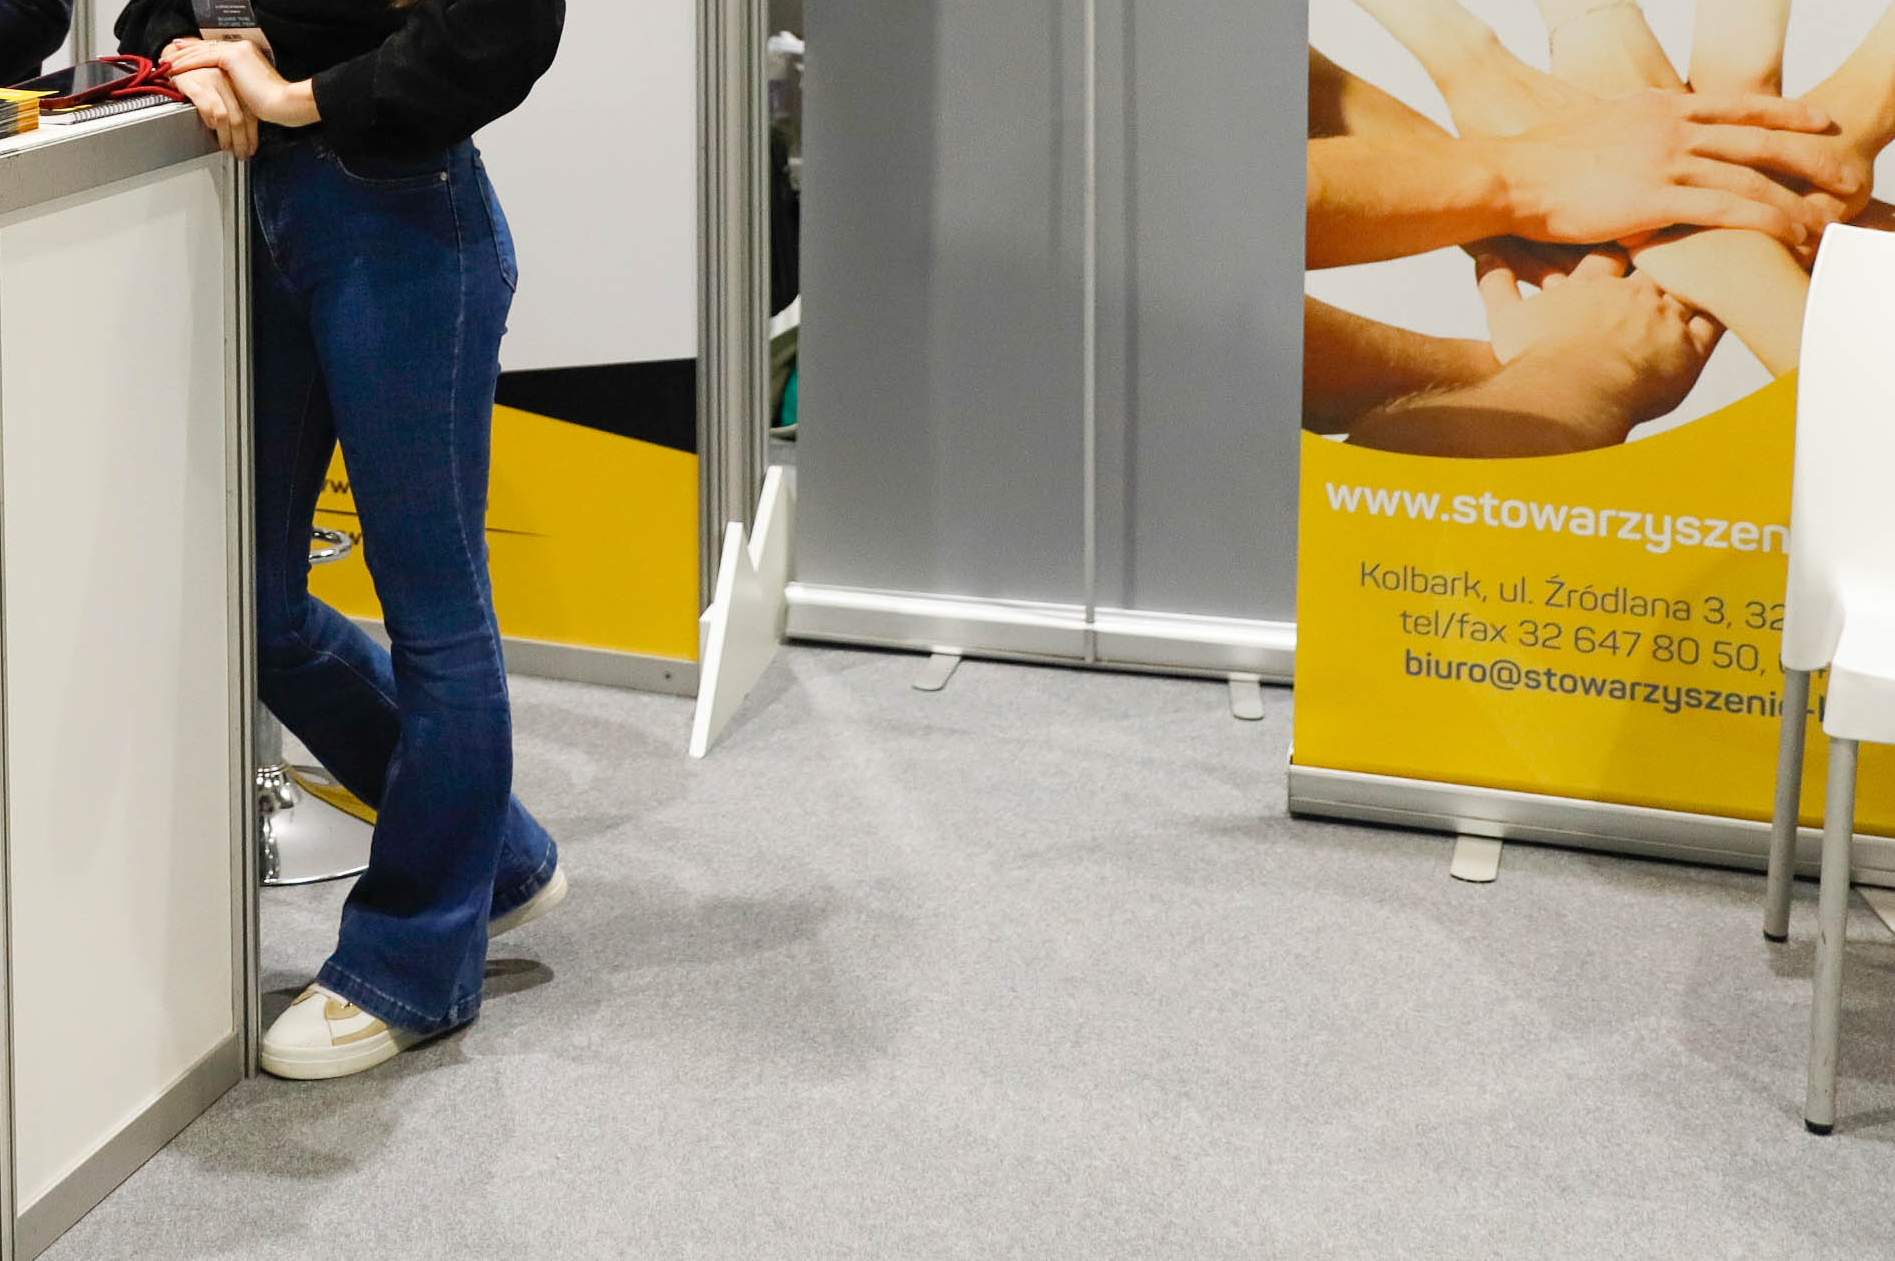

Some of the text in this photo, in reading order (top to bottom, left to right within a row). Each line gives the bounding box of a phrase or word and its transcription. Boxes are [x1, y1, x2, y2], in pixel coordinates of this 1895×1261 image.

[1325, 482, 1790, 555] www.stowarzyszen
[1360, 561, 1488, 604] Kolbark,
[1500, 581, 1533, 605] ul.
[1545, 576, 1691, 623] Źródlana
[1704, 596, 1733, 629] 3,
[1399, 610, 1508, 643] tel/fax
[1519, 620, 1564, 650] 32
[1574, 625, 1642, 659] 647
[1653, 634, 1700, 666] 80
[1712, 643, 1766, 677] 50,
